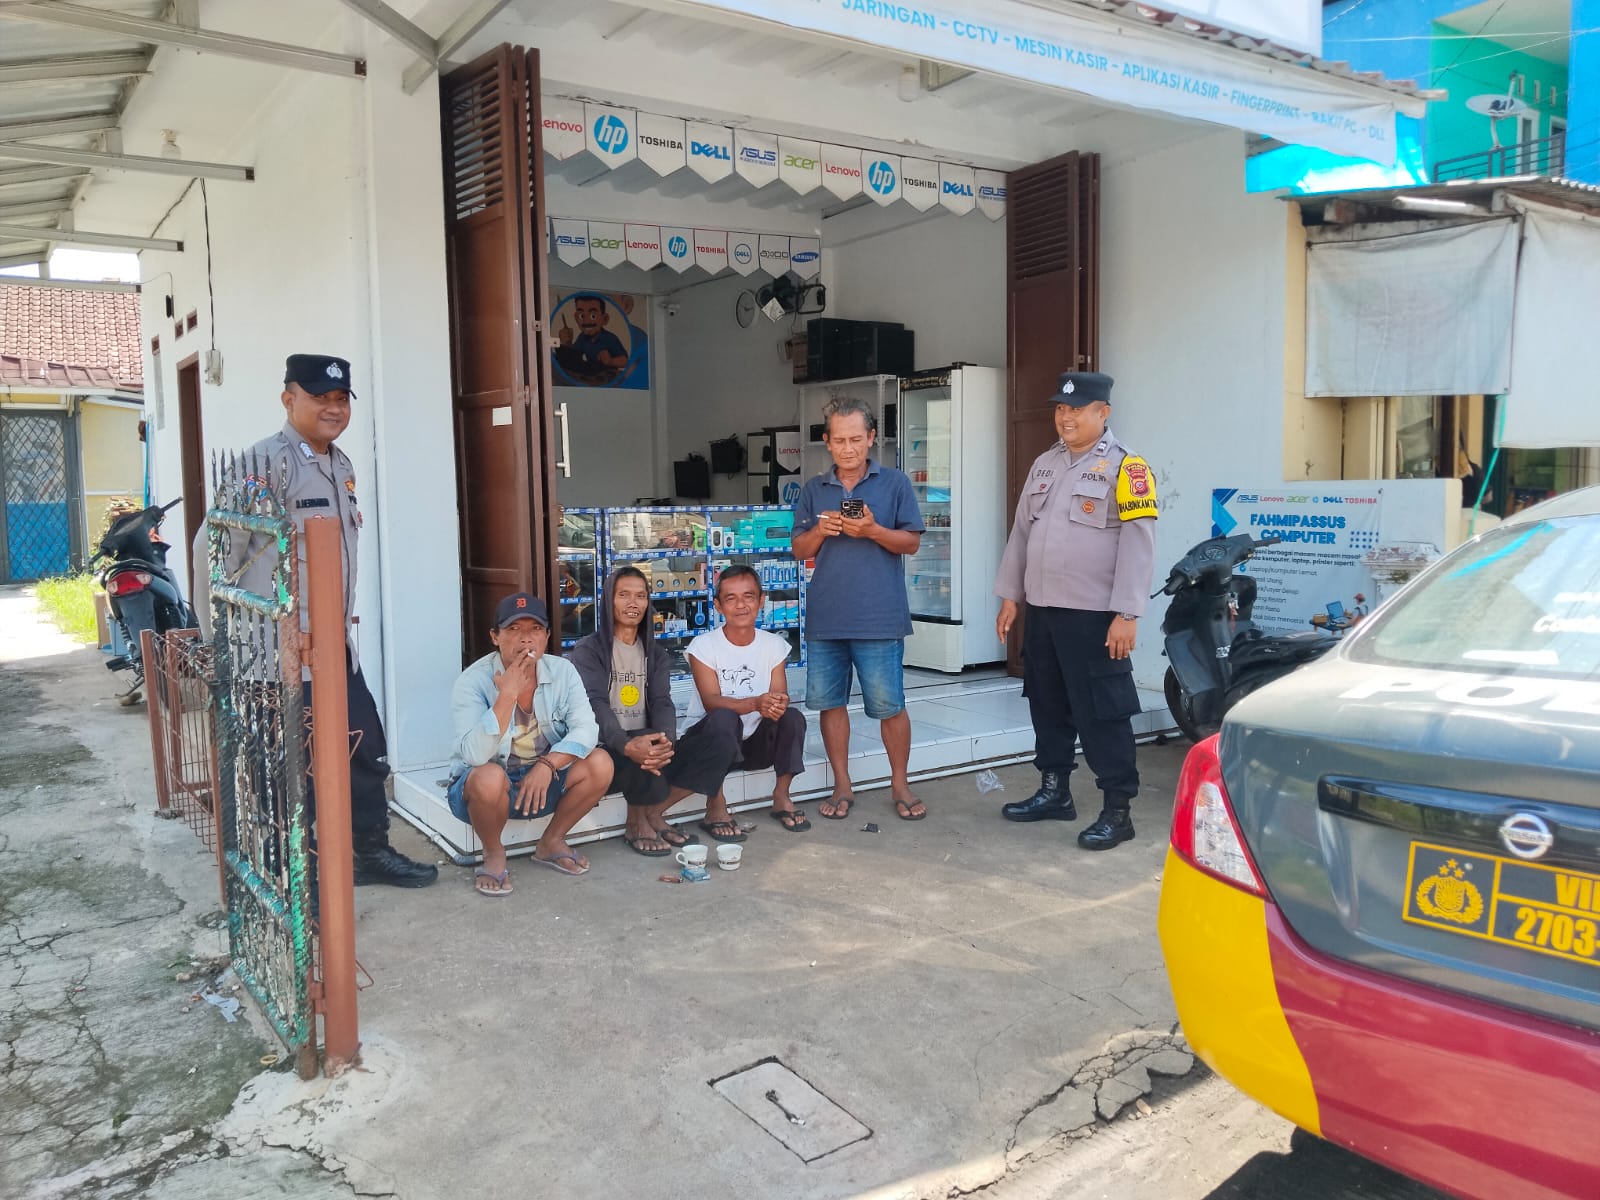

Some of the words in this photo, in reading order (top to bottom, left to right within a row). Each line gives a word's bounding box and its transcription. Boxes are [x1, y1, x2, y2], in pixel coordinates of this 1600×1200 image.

[842, 0, 935, 30] JARINGAN
[953, 20, 998, 45] CCTV
[1015, 35, 1062, 60] MESIN
[1065, 47, 1108, 71] KASIR
[1122, 62, 1180, 90] APLIKASI
[1182, 77, 1220, 99] KASIR
[1231, 90, 1300, 119] FINGERPRINT
[542, 119, 583, 133] enovo
[597, 114, 627, 154] hp
[640, 135, 684, 151] TOSHIBA
[691, 141, 731, 161] DELL
[740, 147, 776, 161] ASUS
[784, 154, 819, 170] acer
[825, 162, 861, 178] Lenovo
[870, 160, 895, 196] hp
[904, 177, 938, 190] TOSHIBA
[943, 181, 974, 197] DELL
[979, 186, 1007, 197] ASUS
[555, 235, 586, 245] ASUS
[591, 237, 625, 250] acer
[627, 239, 659, 250] Lenovo
[669, 235, 687, 259] hp
[696, 246, 727, 255] TOSHIBA
[735, 249, 751, 258] DELL
[779, 447, 801, 455] Lenov
[1322, 496, 1344, 504] DELL
[1345, 497, 1378, 505] TOSHIBA
[1250, 514, 1346, 529] FAHMIPASSUS
[1261, 529, 1337, 545] COMPUTER
